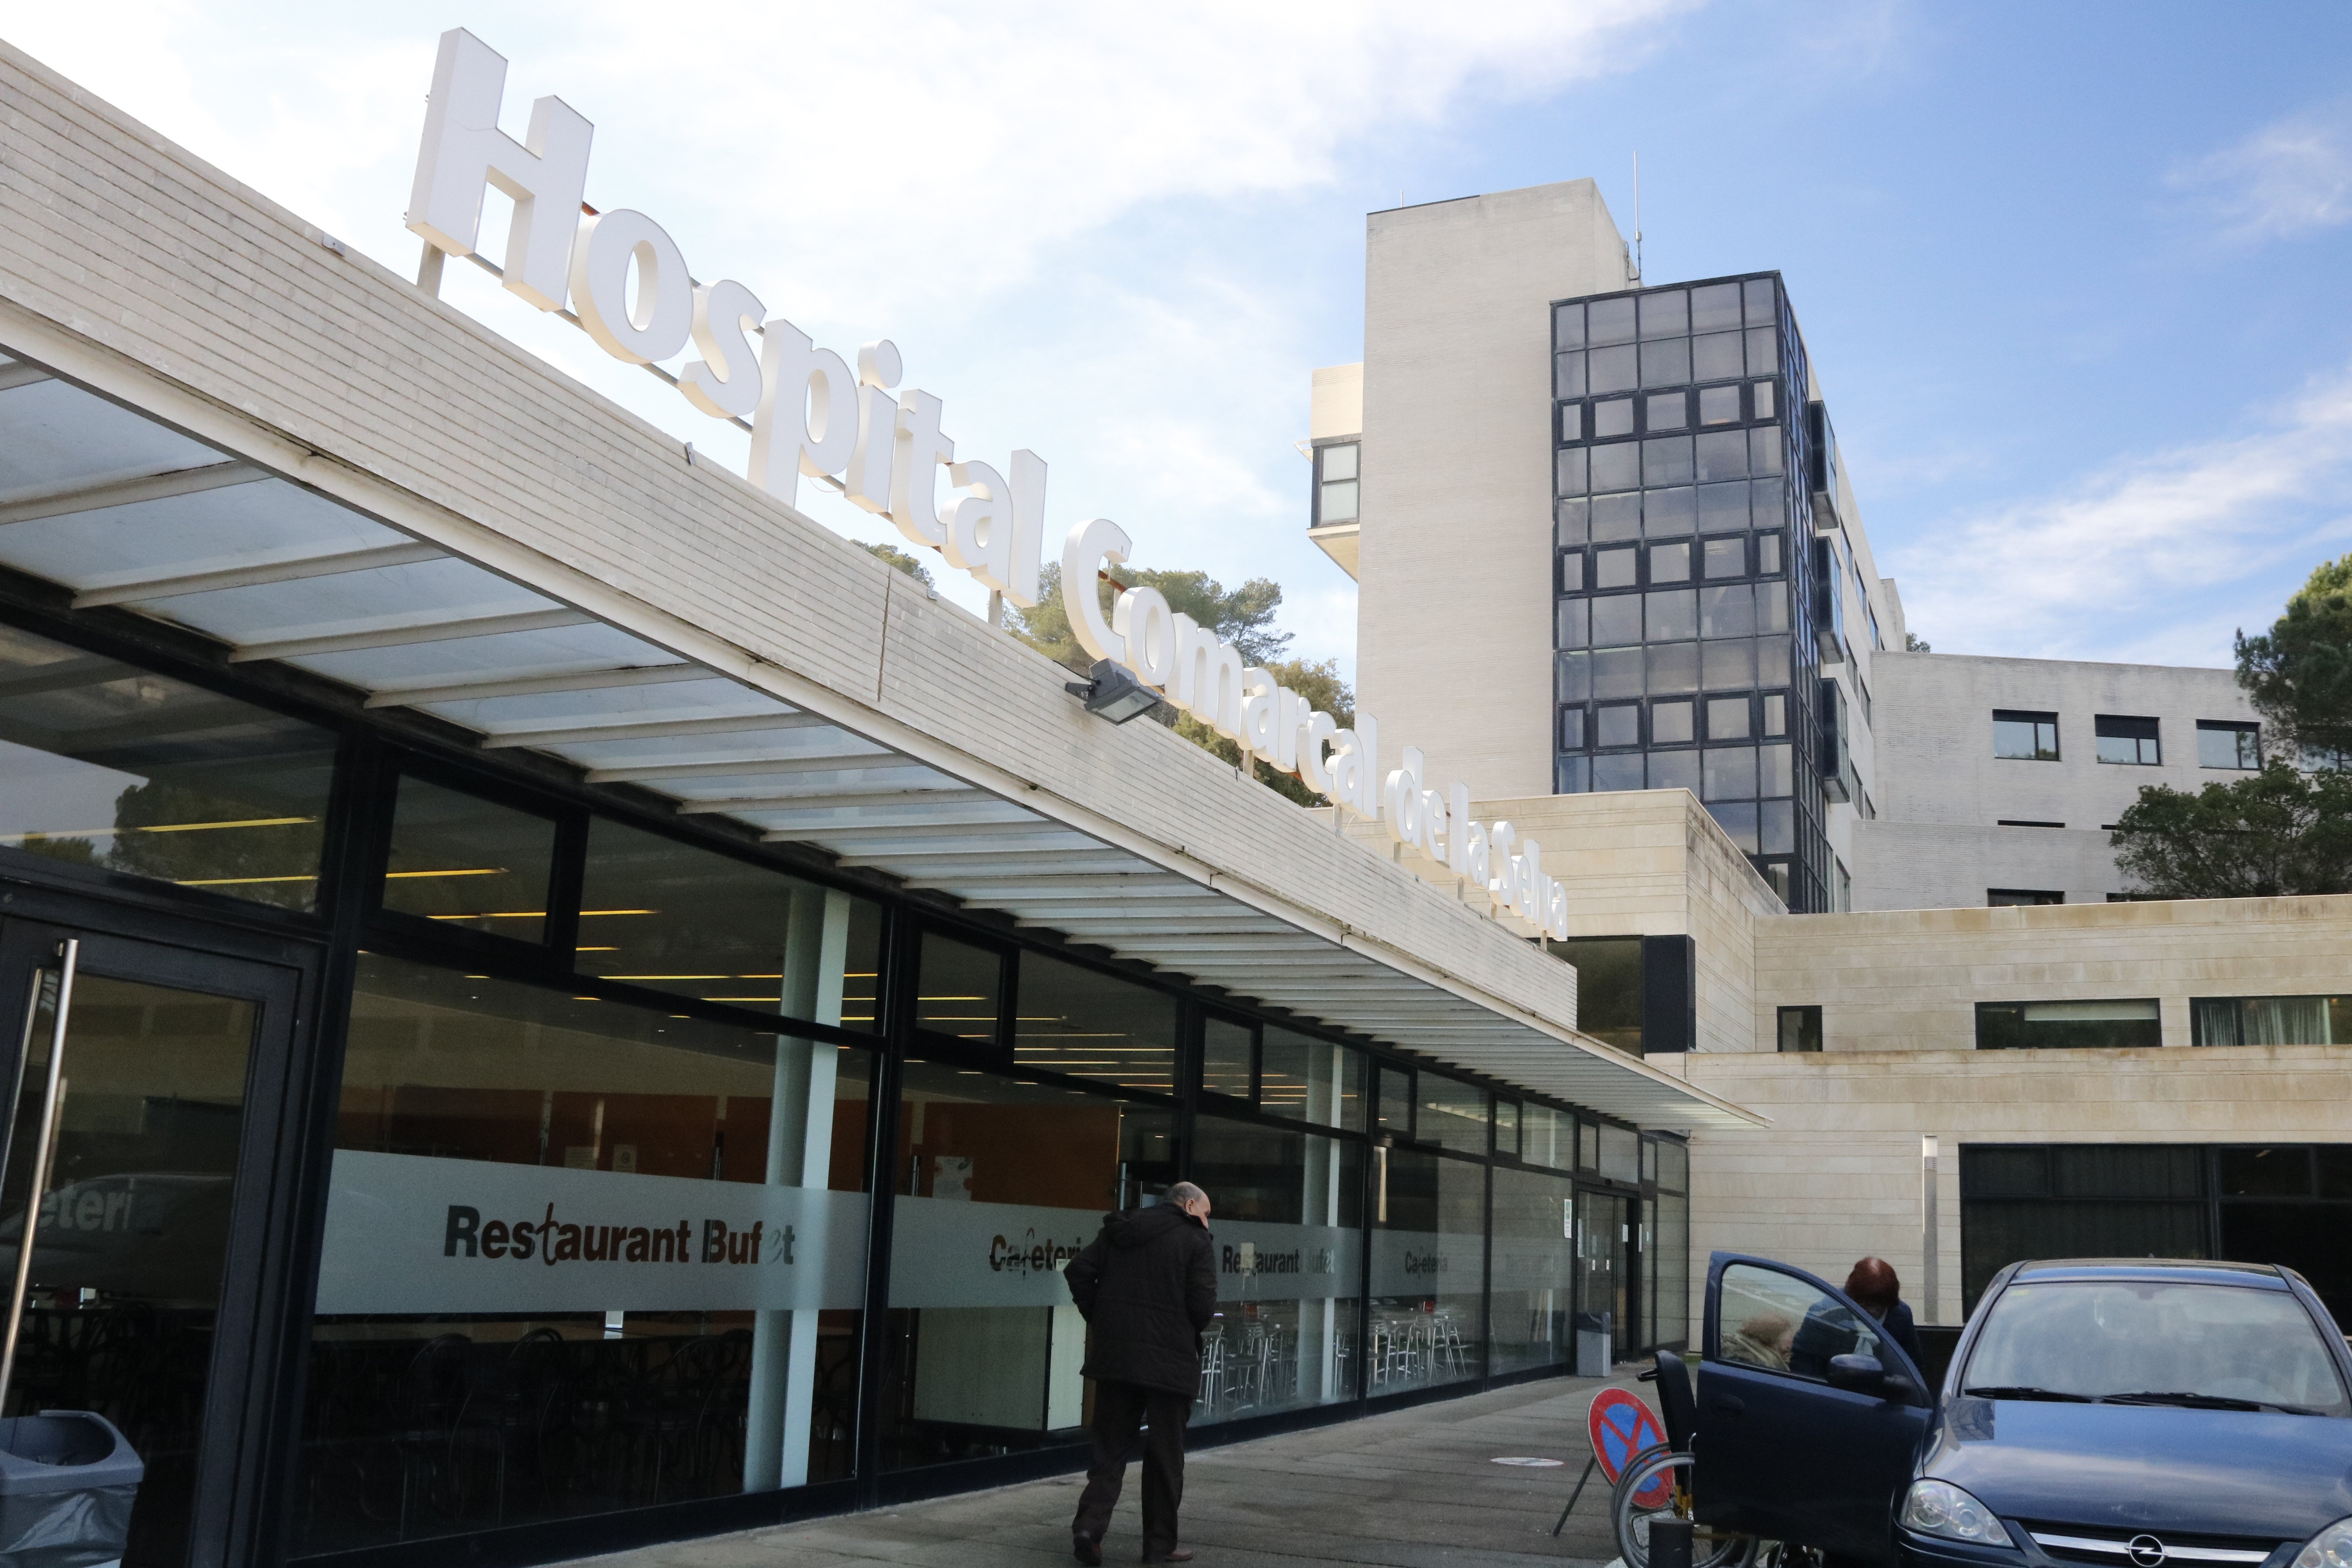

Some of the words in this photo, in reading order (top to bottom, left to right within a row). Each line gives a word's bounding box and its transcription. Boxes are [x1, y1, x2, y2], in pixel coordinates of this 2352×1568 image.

[407, 27, 1047, 608] Hospital
[1062, 519, 1377, 820] Comarcal
[1385, 747, 1445, 861] de
[1450, 783, 1490, 887] la
[1490, 821, 1567, 942] Selva
[443, 1202, 691, 1266] Restaurant
[702, 1219, 795, 1265] Bufet
